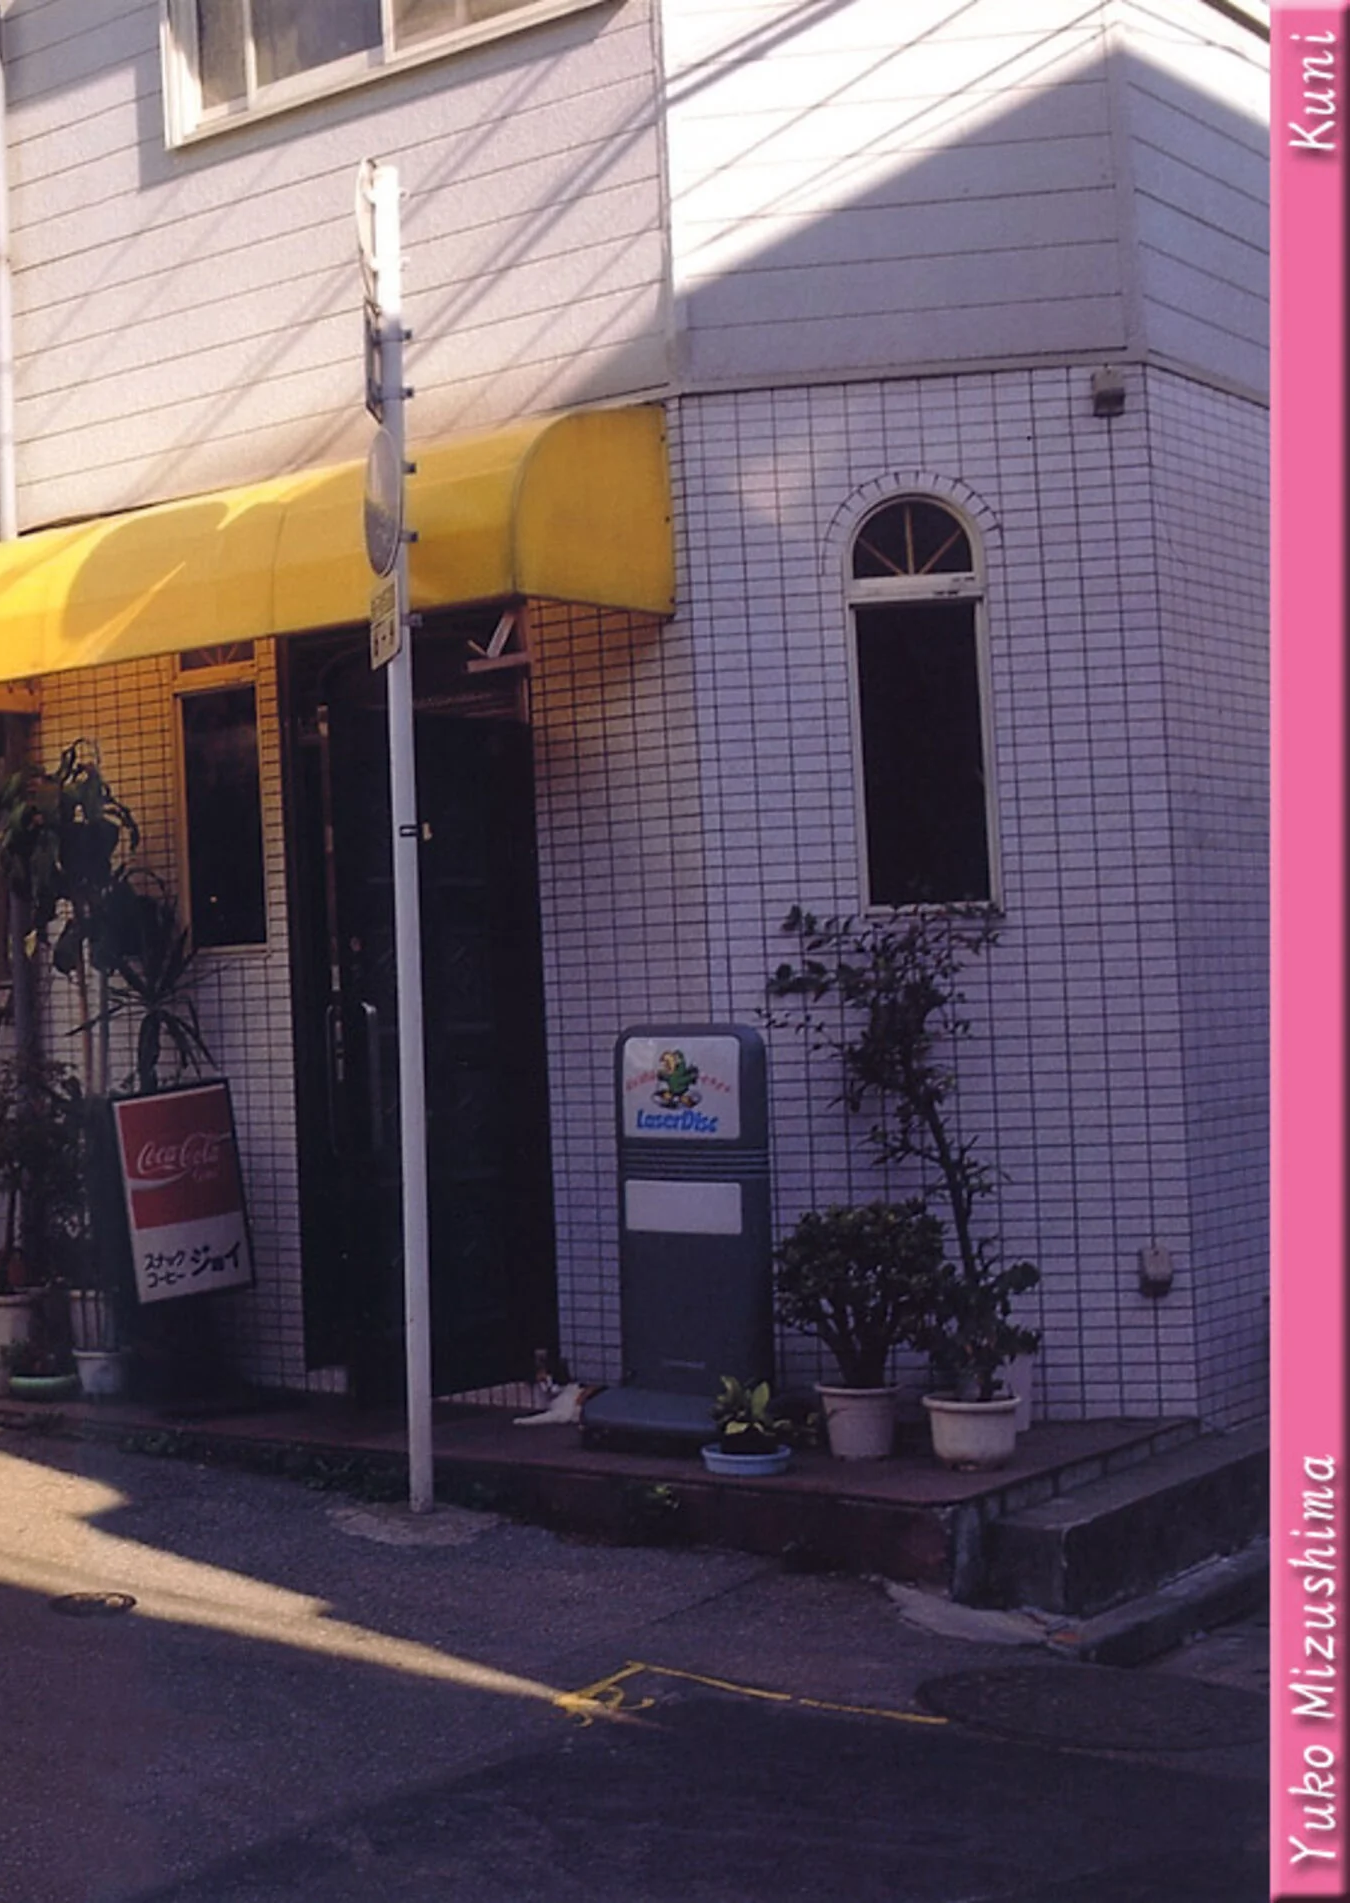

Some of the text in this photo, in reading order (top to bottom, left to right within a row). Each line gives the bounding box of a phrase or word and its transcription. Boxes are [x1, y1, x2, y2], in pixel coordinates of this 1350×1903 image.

[636, 1108, 719, 1133] LaserDisc
[144, 1250, 185, 1271] スナック
[191, 1241, 241, 1276] ジョイ
[147, 1271, 186, 1288] コーヒー
